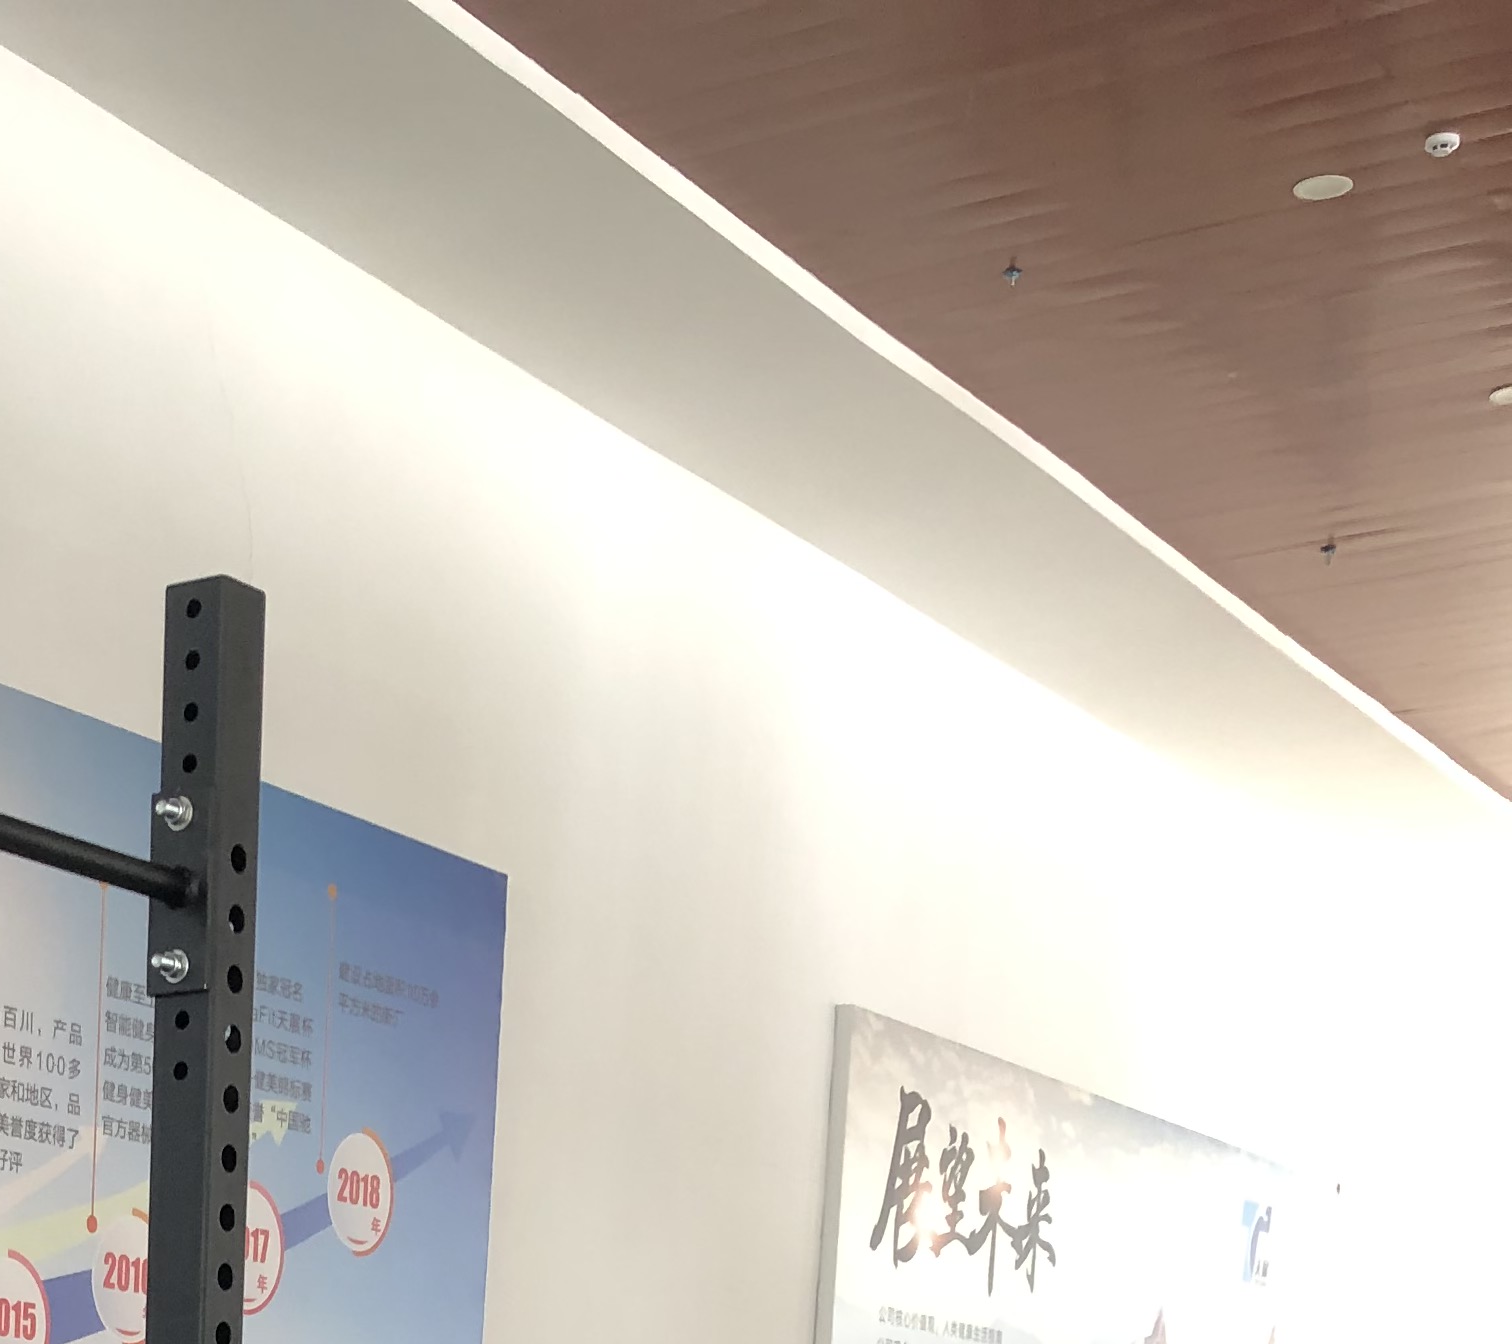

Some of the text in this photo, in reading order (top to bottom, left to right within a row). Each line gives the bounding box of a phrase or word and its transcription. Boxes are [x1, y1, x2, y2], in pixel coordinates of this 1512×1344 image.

[337, 1168, 381, 1209] 2018
[869, 1085, 1056, 1297] 展望未来
[370, 1217, 382, 1236] 年
[257, 1274, 268, 1294] 年
